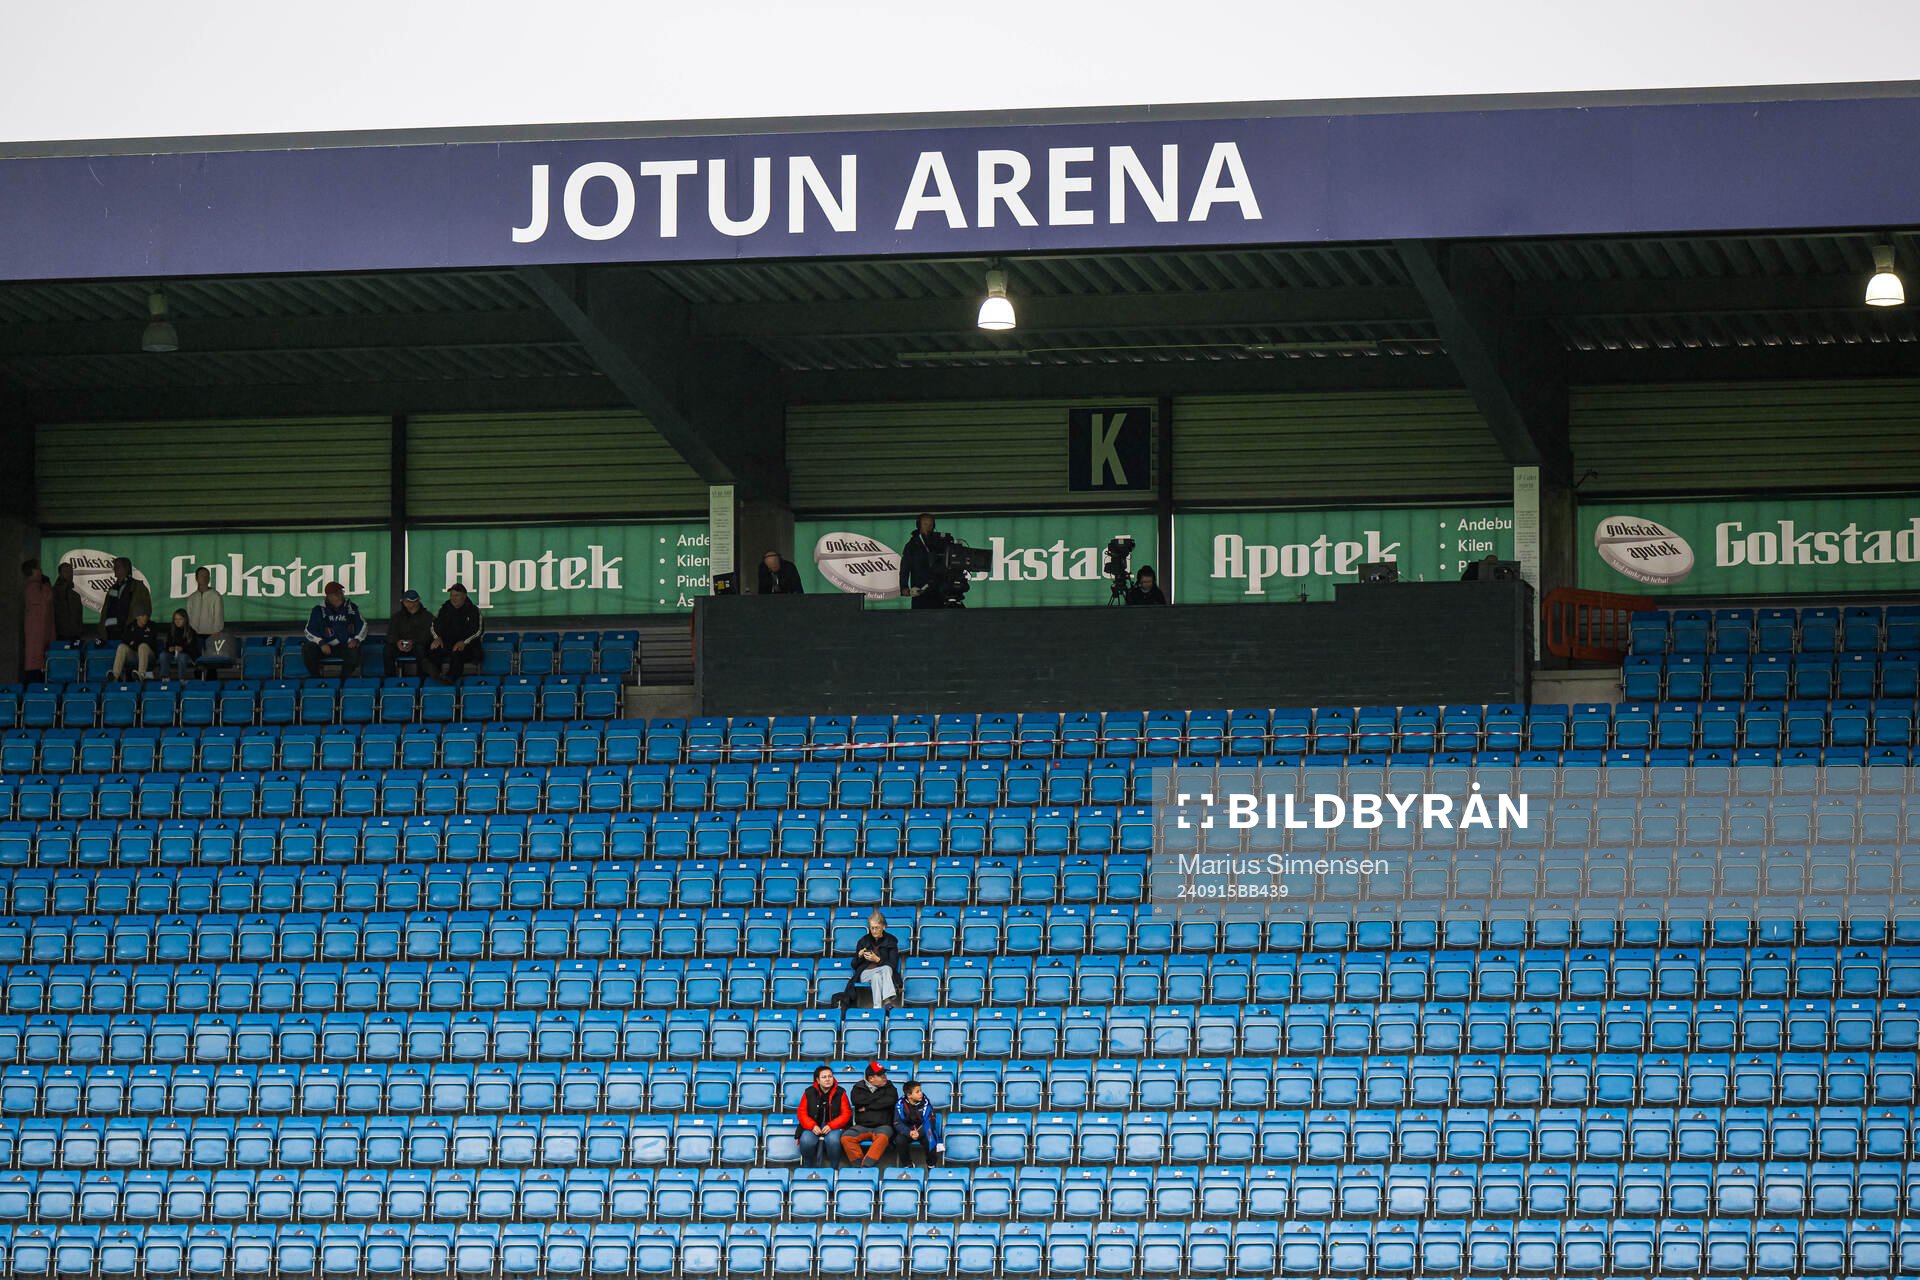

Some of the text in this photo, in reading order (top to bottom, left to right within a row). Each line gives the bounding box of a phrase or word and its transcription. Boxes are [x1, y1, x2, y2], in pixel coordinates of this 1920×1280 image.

[511, 141, 1263, 243] JOTUN ARENA
[1091, 413, 1128, 486] K
[1457, 517, 1512, 531] Andebu
[1606, 523, 1665, 537] gokstad
[826, 539, 882, 553] gokstad
[1458, 539, 1493, 552] Kilen
[1627, 541, 1682, 560] apotek
[677, 554, 710, 567] Kilen
[845, 557, 898, 576] apotek
[1210, 531, 1401, 595] Apotek
[442, 545, 623, 609] Apotek
